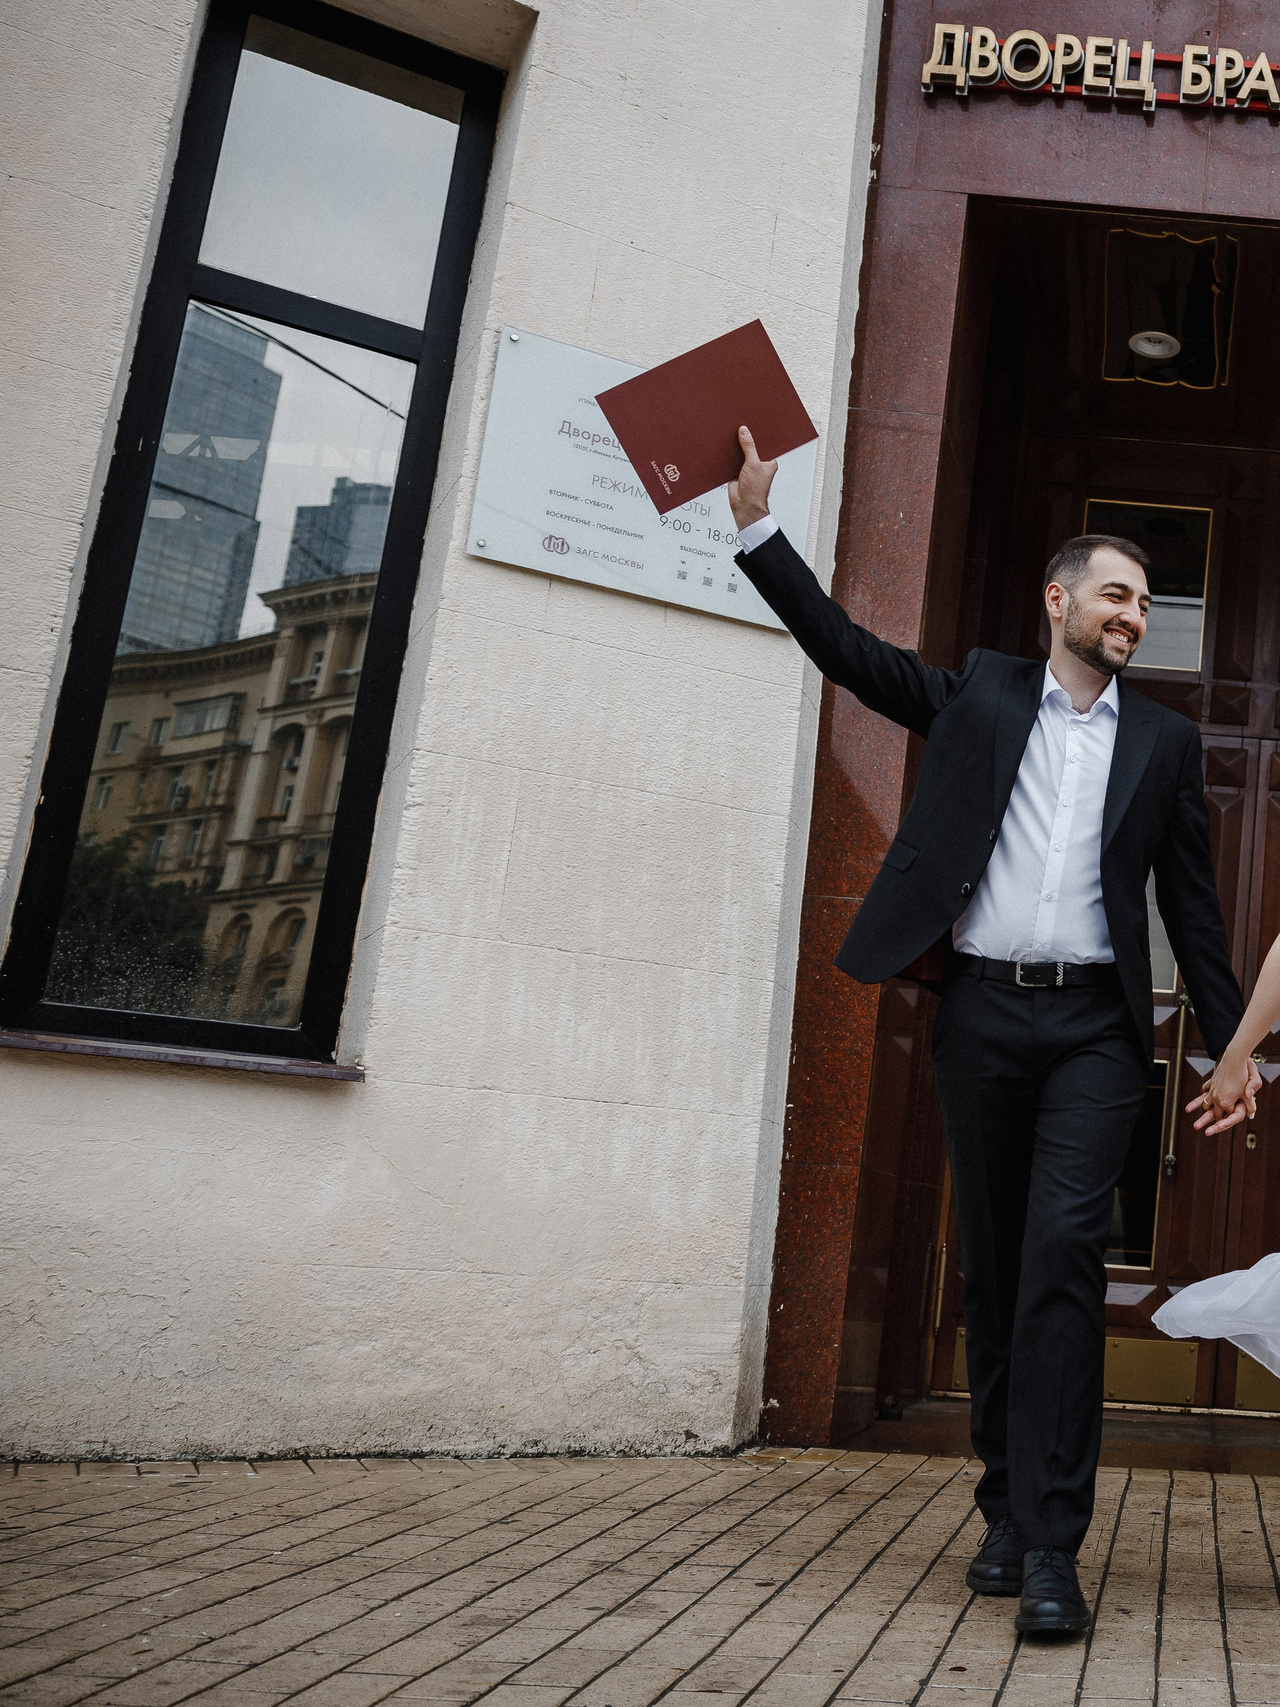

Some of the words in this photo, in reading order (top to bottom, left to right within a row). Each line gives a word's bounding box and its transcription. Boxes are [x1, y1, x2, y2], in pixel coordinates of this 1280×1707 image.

[921, 23, 1156, 112] ДВОРЕЦ
[558, 420, 621, 451] Дворец
[592, 474, 648, 500] РЕЖИМ
[549, 489, 579, 502] ВТОРНИК
[584, 498, 614, 511] СУББОТА
[546, 510, 591, 526] ВОСКРЕСЕНЬЕ
[596, 523, 644, 540] ПОНЕДЕЛЬНИК
[659, 515, 692, 534] 9:00
[575, 547, 600, 559] ЗАГС
[601, 553, 644, 570] МОСКВЫ
[680, 545, 716, 559] ВЫХОДНОЙ
